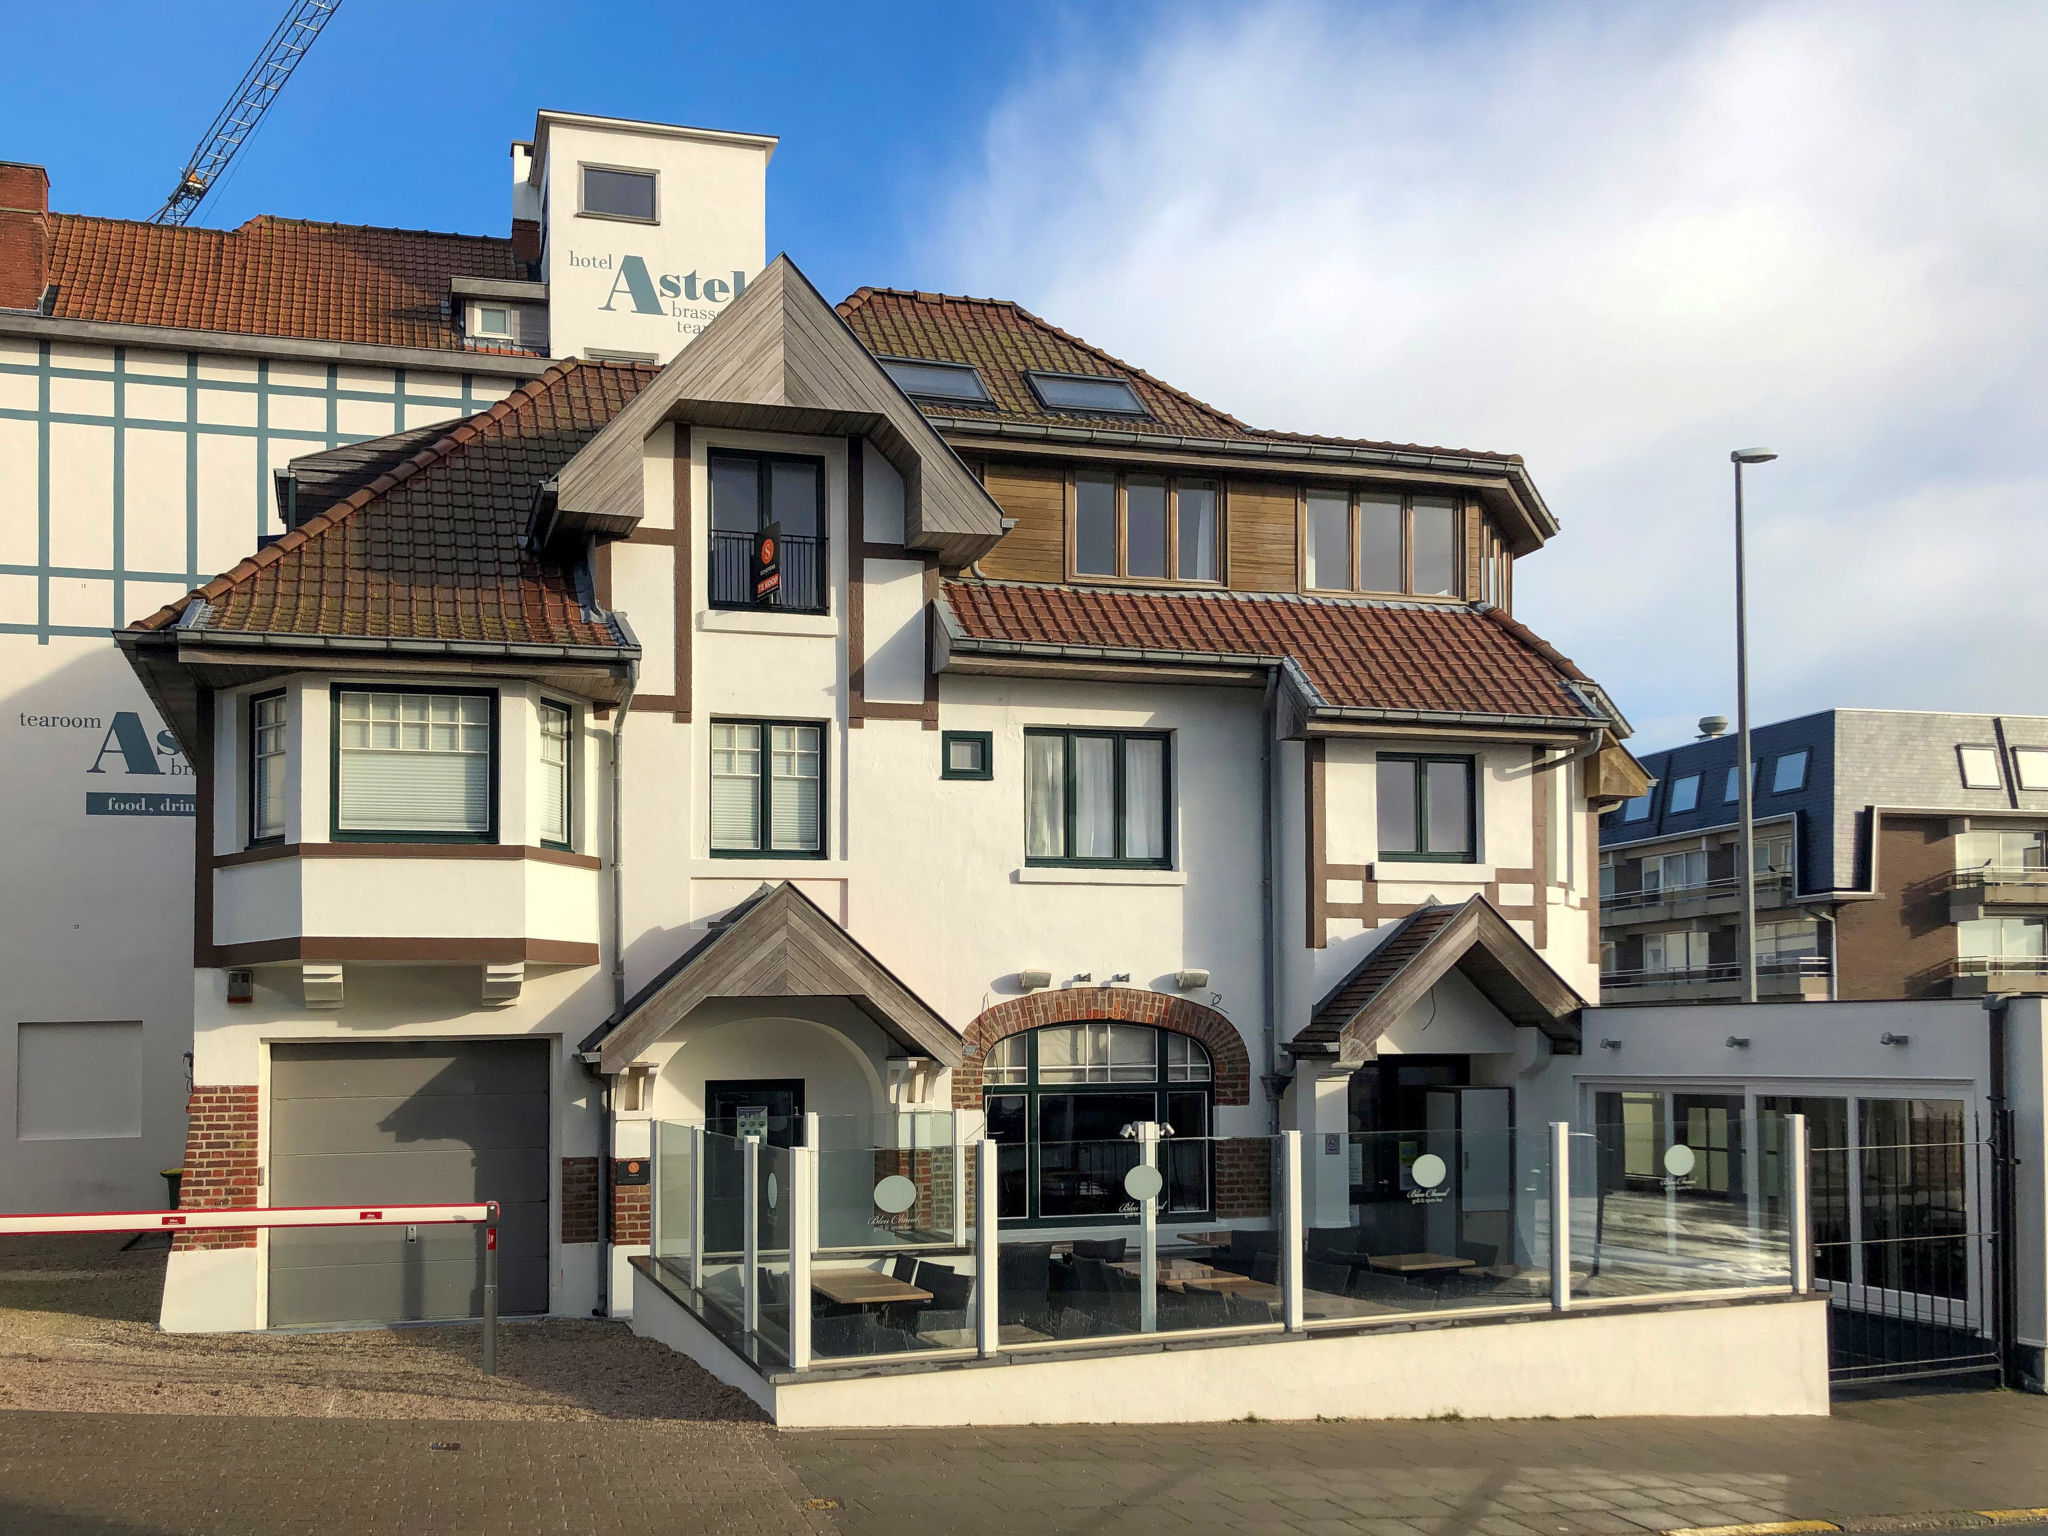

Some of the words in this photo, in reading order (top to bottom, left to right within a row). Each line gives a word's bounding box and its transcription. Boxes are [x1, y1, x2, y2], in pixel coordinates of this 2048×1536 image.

[568, 250, 612, 269] hotel
[20, 712, 102, 729] tearoom
[107, 797, 154, 812] food,
[867, 1214, 889, 1225] Bleu
[891, 1213, 921, 1225] Chaud
